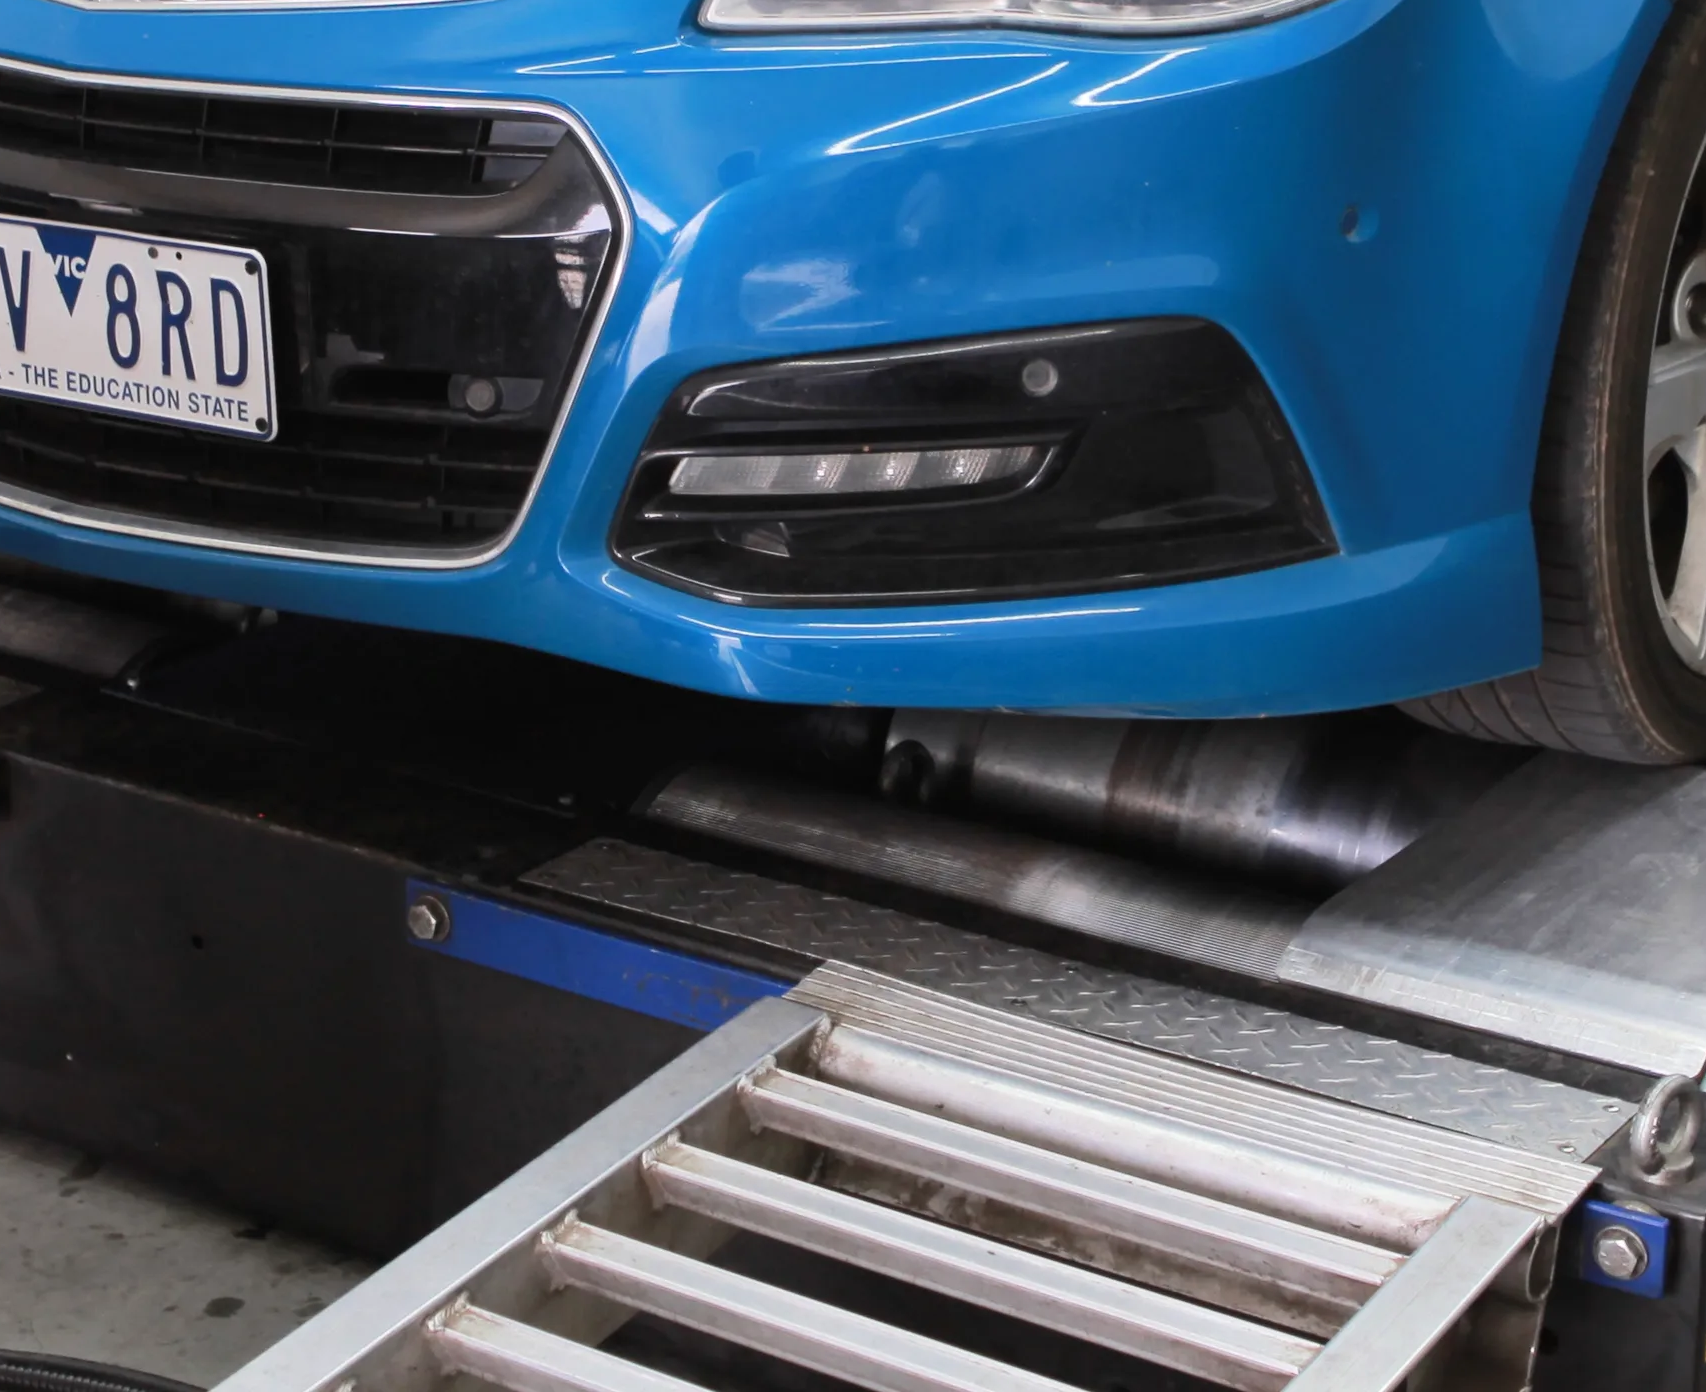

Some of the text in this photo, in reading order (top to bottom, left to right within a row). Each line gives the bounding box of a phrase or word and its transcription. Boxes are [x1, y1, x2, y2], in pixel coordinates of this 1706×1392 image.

[48, 252, 87, 280] VIC
[105, 263, 250, 388] 8RD
[21, 363, 58, 390] THE
[66, 371, 180, 411] EDUCATION
[188, 393, 249, 423] STATE
